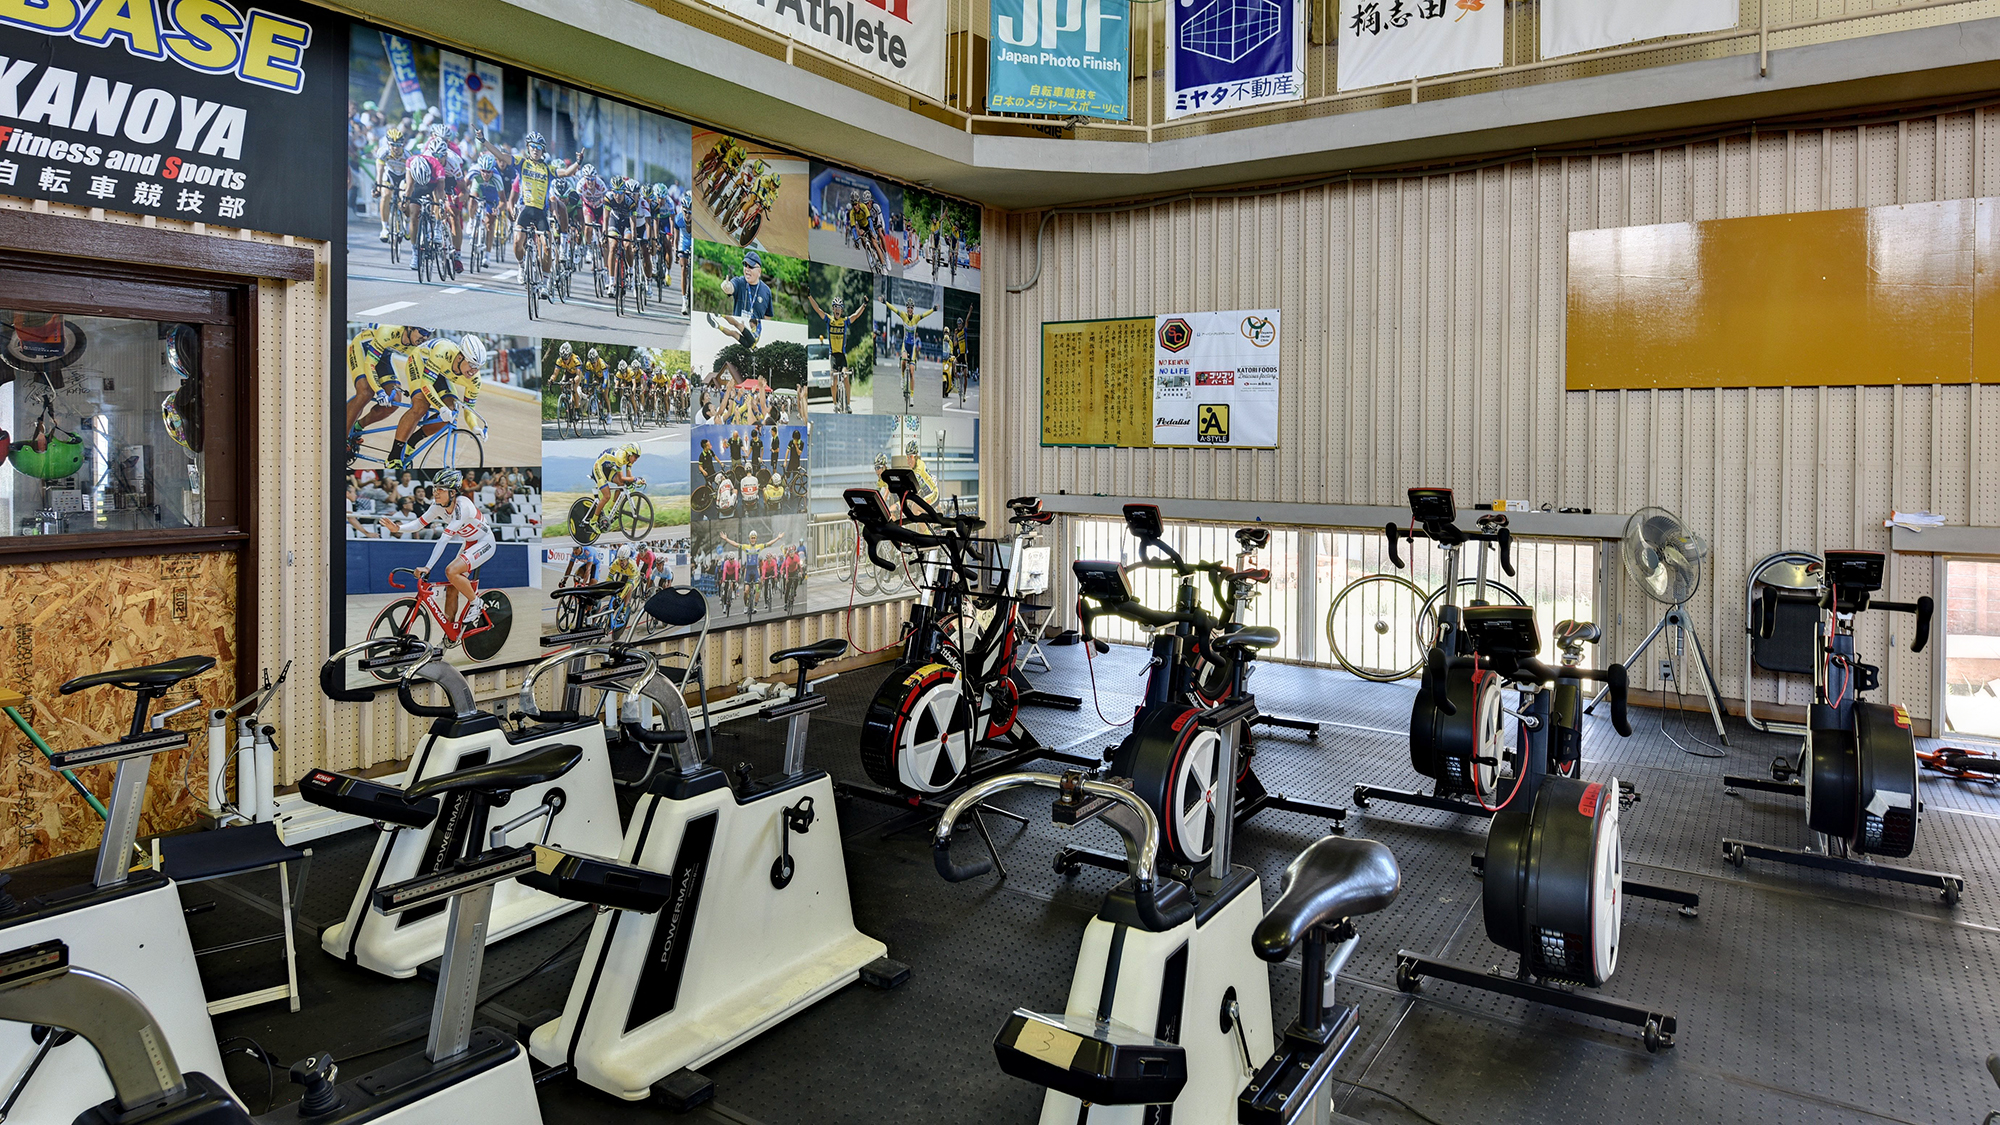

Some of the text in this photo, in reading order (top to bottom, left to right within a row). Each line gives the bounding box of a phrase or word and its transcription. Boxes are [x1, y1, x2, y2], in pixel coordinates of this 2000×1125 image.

[997, 48, 1122, 72] Japan Photo Finish
[1029, 84, 1097, 100] 自転車競技を
[1175, 74, 1294, 111] ミヤタ不動産
[0, 125, 248, 191] Fitness and Sports
[0, 158, 246, 220] 自転車競技部
[1159, 367, 1190, 375] NO LIFE
[1236, 366, 1258, 374] KATORI
[433, 794, 465, 872] POWERMAX
[660, 867, 692, 963] POWERMAX
[1035, 1030, 1056, 1053] 3
